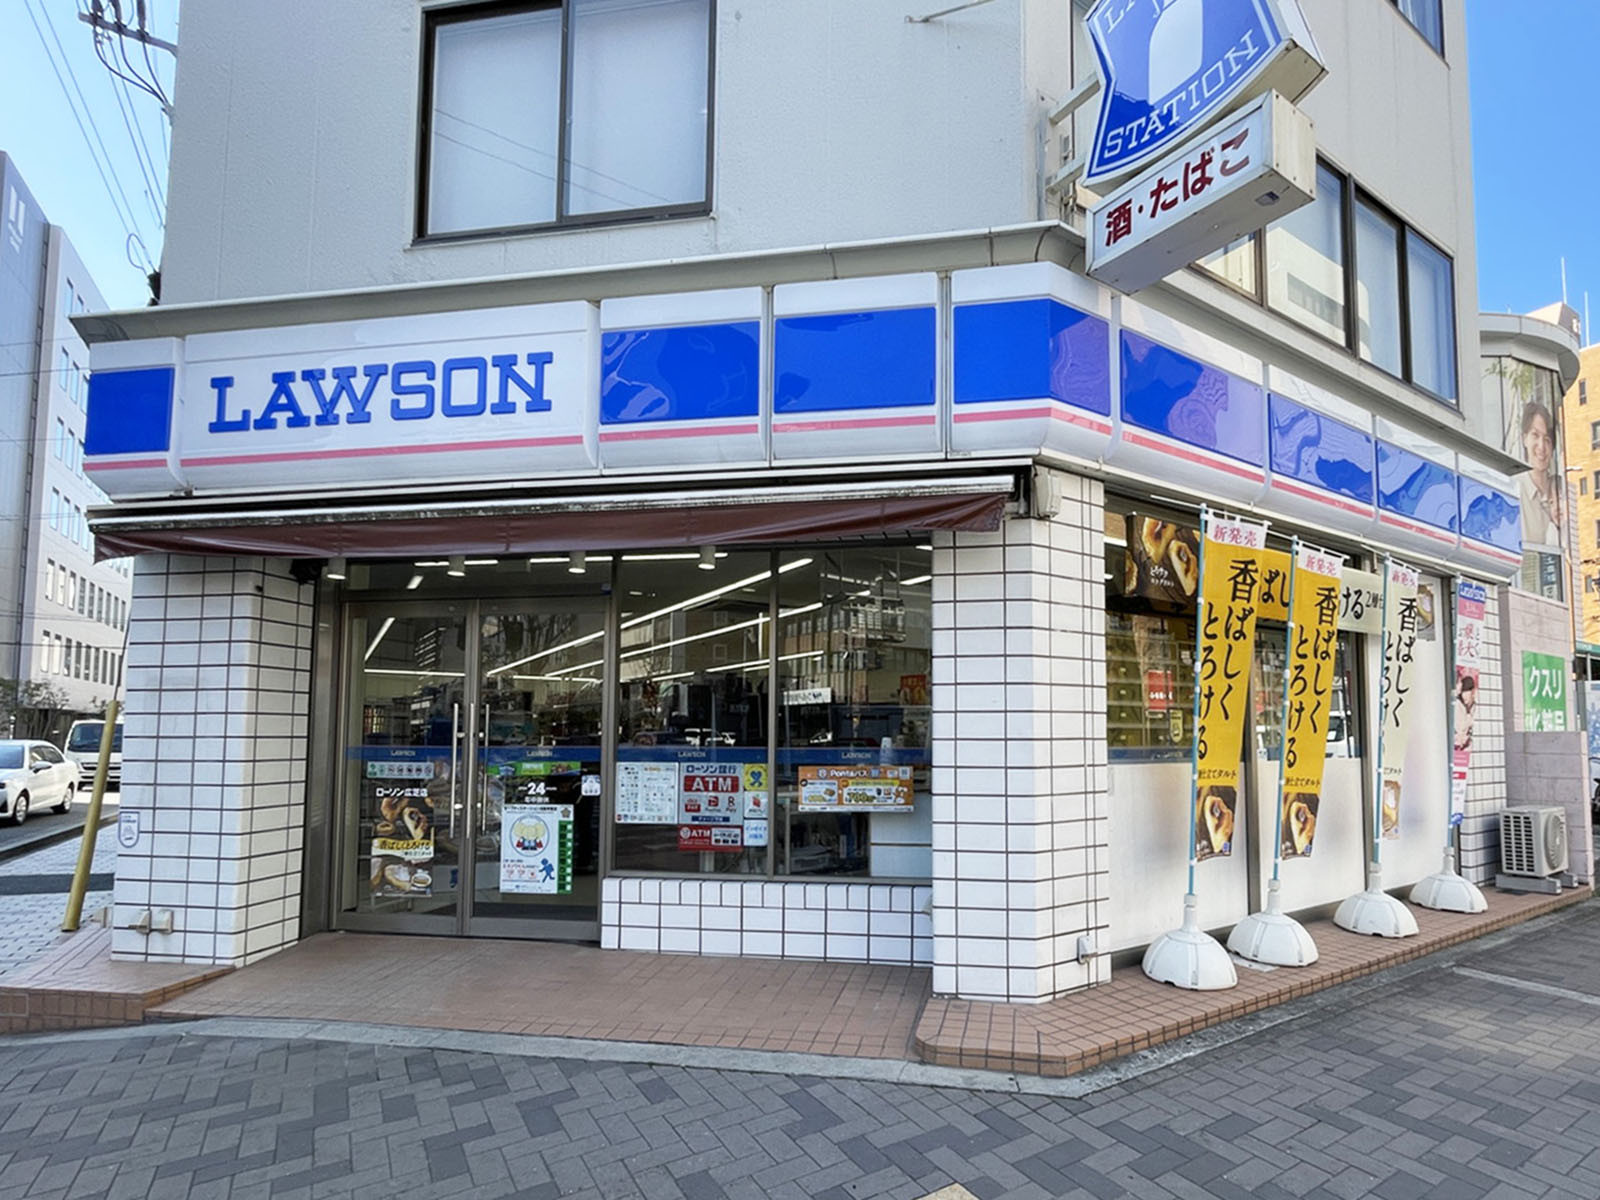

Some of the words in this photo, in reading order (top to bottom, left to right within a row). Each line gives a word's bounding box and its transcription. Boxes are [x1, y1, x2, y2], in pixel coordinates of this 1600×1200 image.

[1103, 28, 1260, 159] STATION
[1106, 128, 1250, 247] 酒・たばこ
[208, 351, 554, 434] LAWSON
[1213, 524, 1257, 547] 新発売
[1219, 559, 1259, 720] 香ばしく
[1306, 587, 1338, 734] 香ばしく
[1392, 597, 1417, 728] 香ばしく
[1286, 624, 1308, 768] とろける
[1529, 664, 1563, 700] クスリ
[528, 781, 546, 796] 24
[685, 764, 737, 775] ローソン銀行
[691, 776, 732, 792] ATM
[691, 829, 711, 838] ATM
